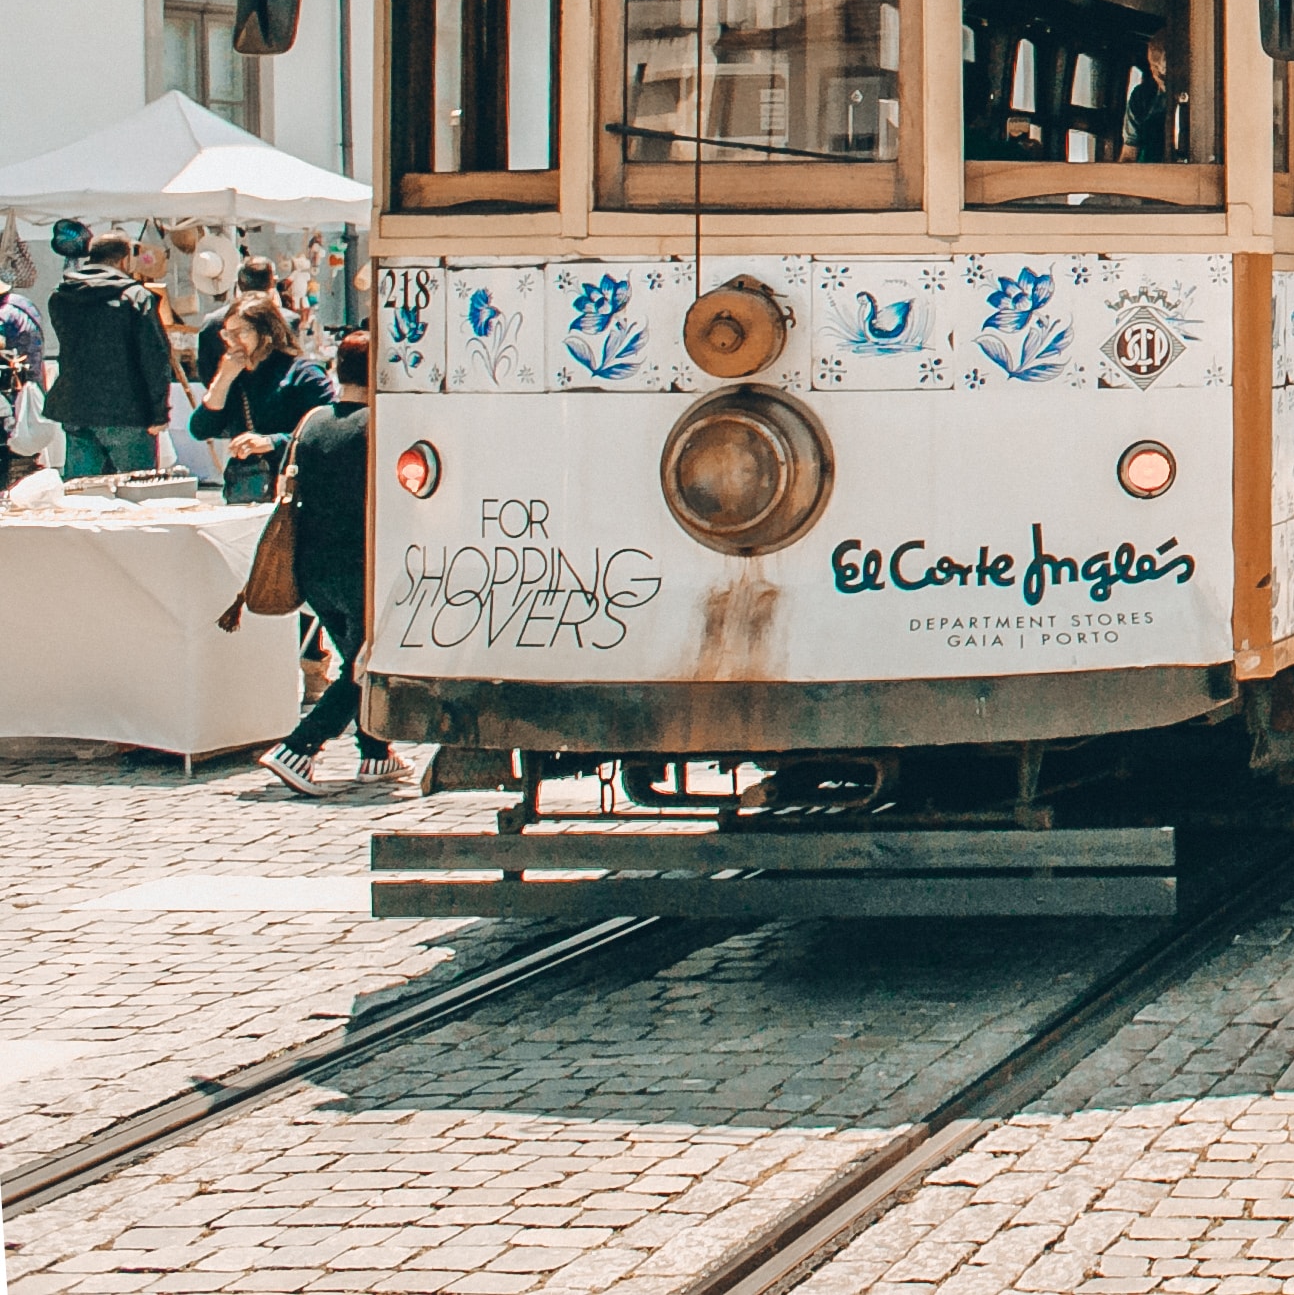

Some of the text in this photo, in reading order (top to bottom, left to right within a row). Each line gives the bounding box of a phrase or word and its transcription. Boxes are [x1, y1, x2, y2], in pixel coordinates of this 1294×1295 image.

[383, 269, 431, 311] 218
[481, 498, 550, 539] FOR
[395, 544, 662, 608] SHOPPING
[831, 522, 1196, 606] El Corte Inglés
[399, 589, 628, 650] LOVERS
[909, 611, 1155, 632] DEPARTMENT STORES
[947, 634, 1005, 648] GAIA
[1041, 630, 1120, 646] PORTO
